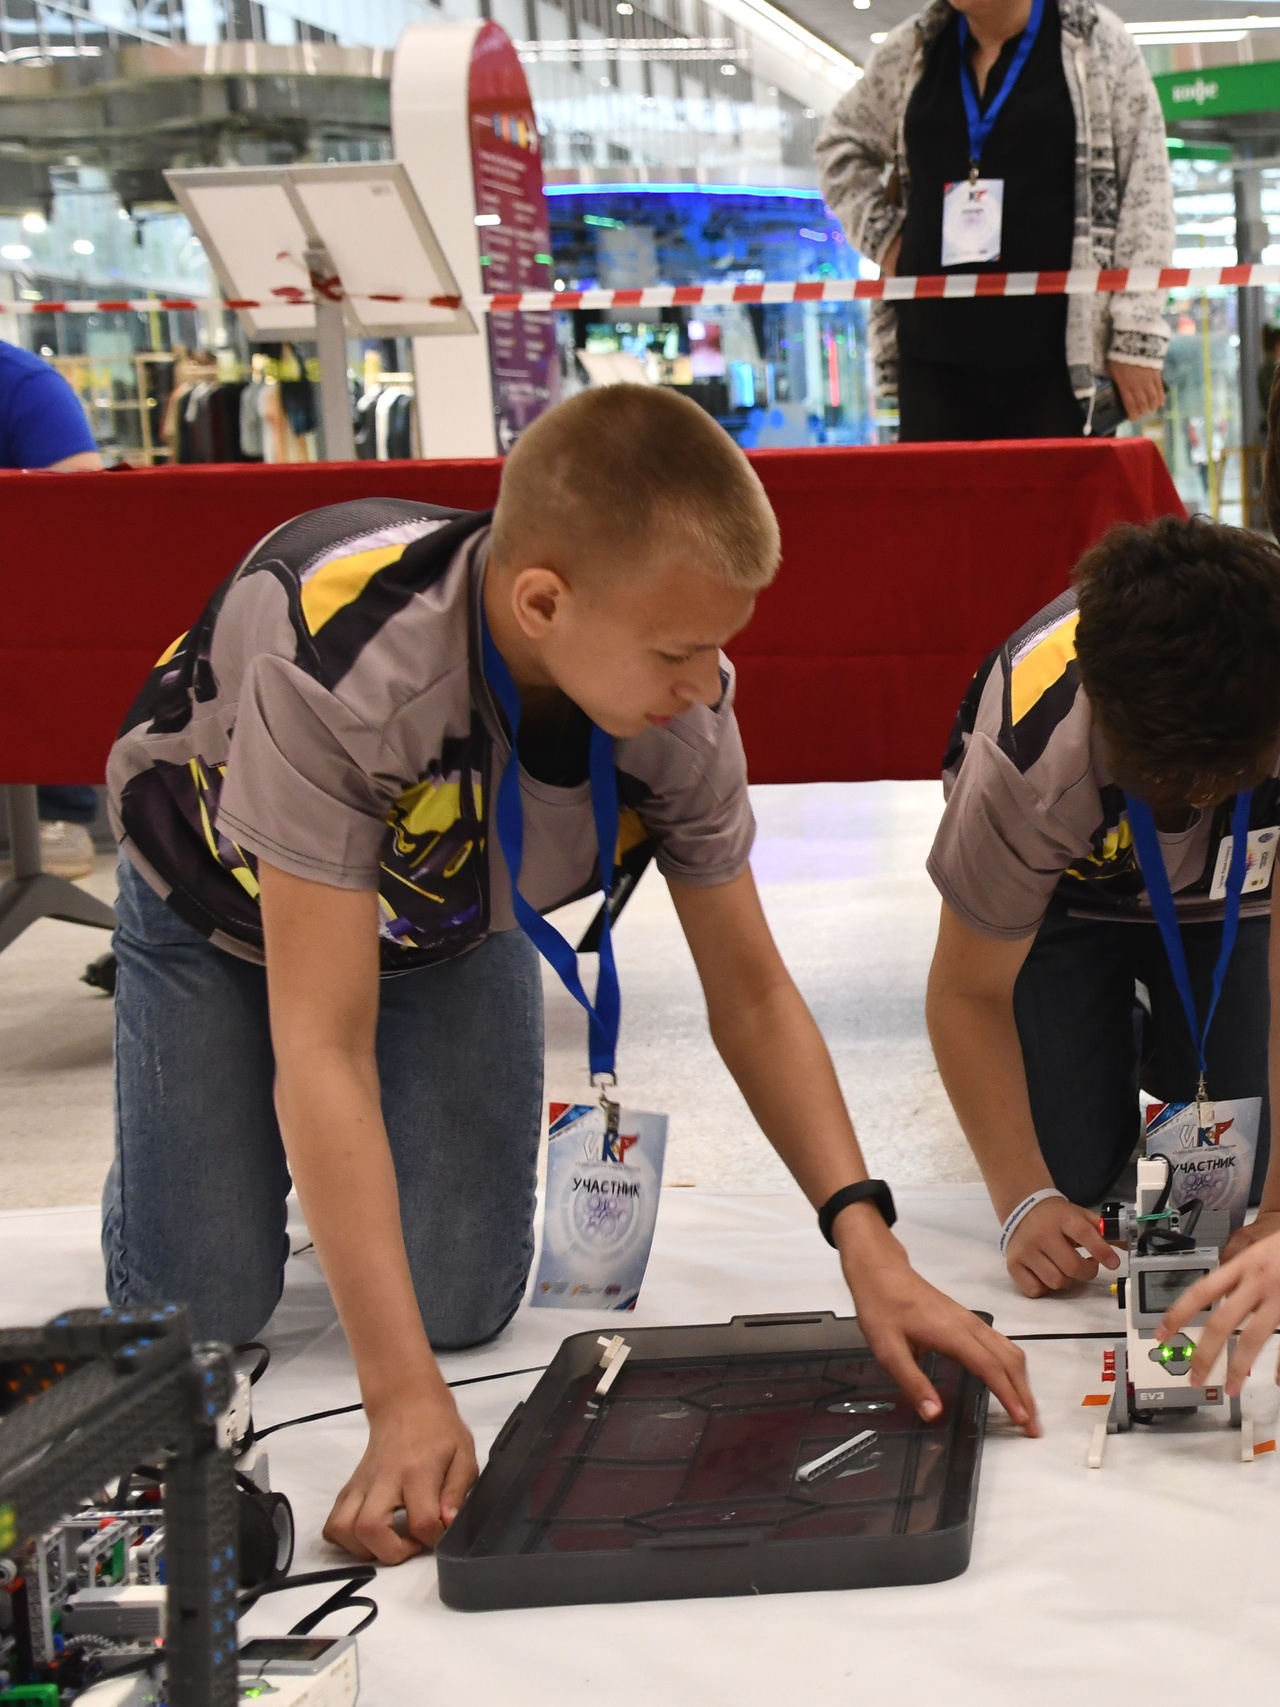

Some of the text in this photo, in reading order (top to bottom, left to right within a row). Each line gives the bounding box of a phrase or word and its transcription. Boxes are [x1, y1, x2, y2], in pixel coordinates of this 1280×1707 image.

[1172, 1156, 1236, 1174] УЧАСТНИК
[572, 1177, 640, 1198] УЧАСТНИК
[1140, 1391, 1165, 1401] EV3
